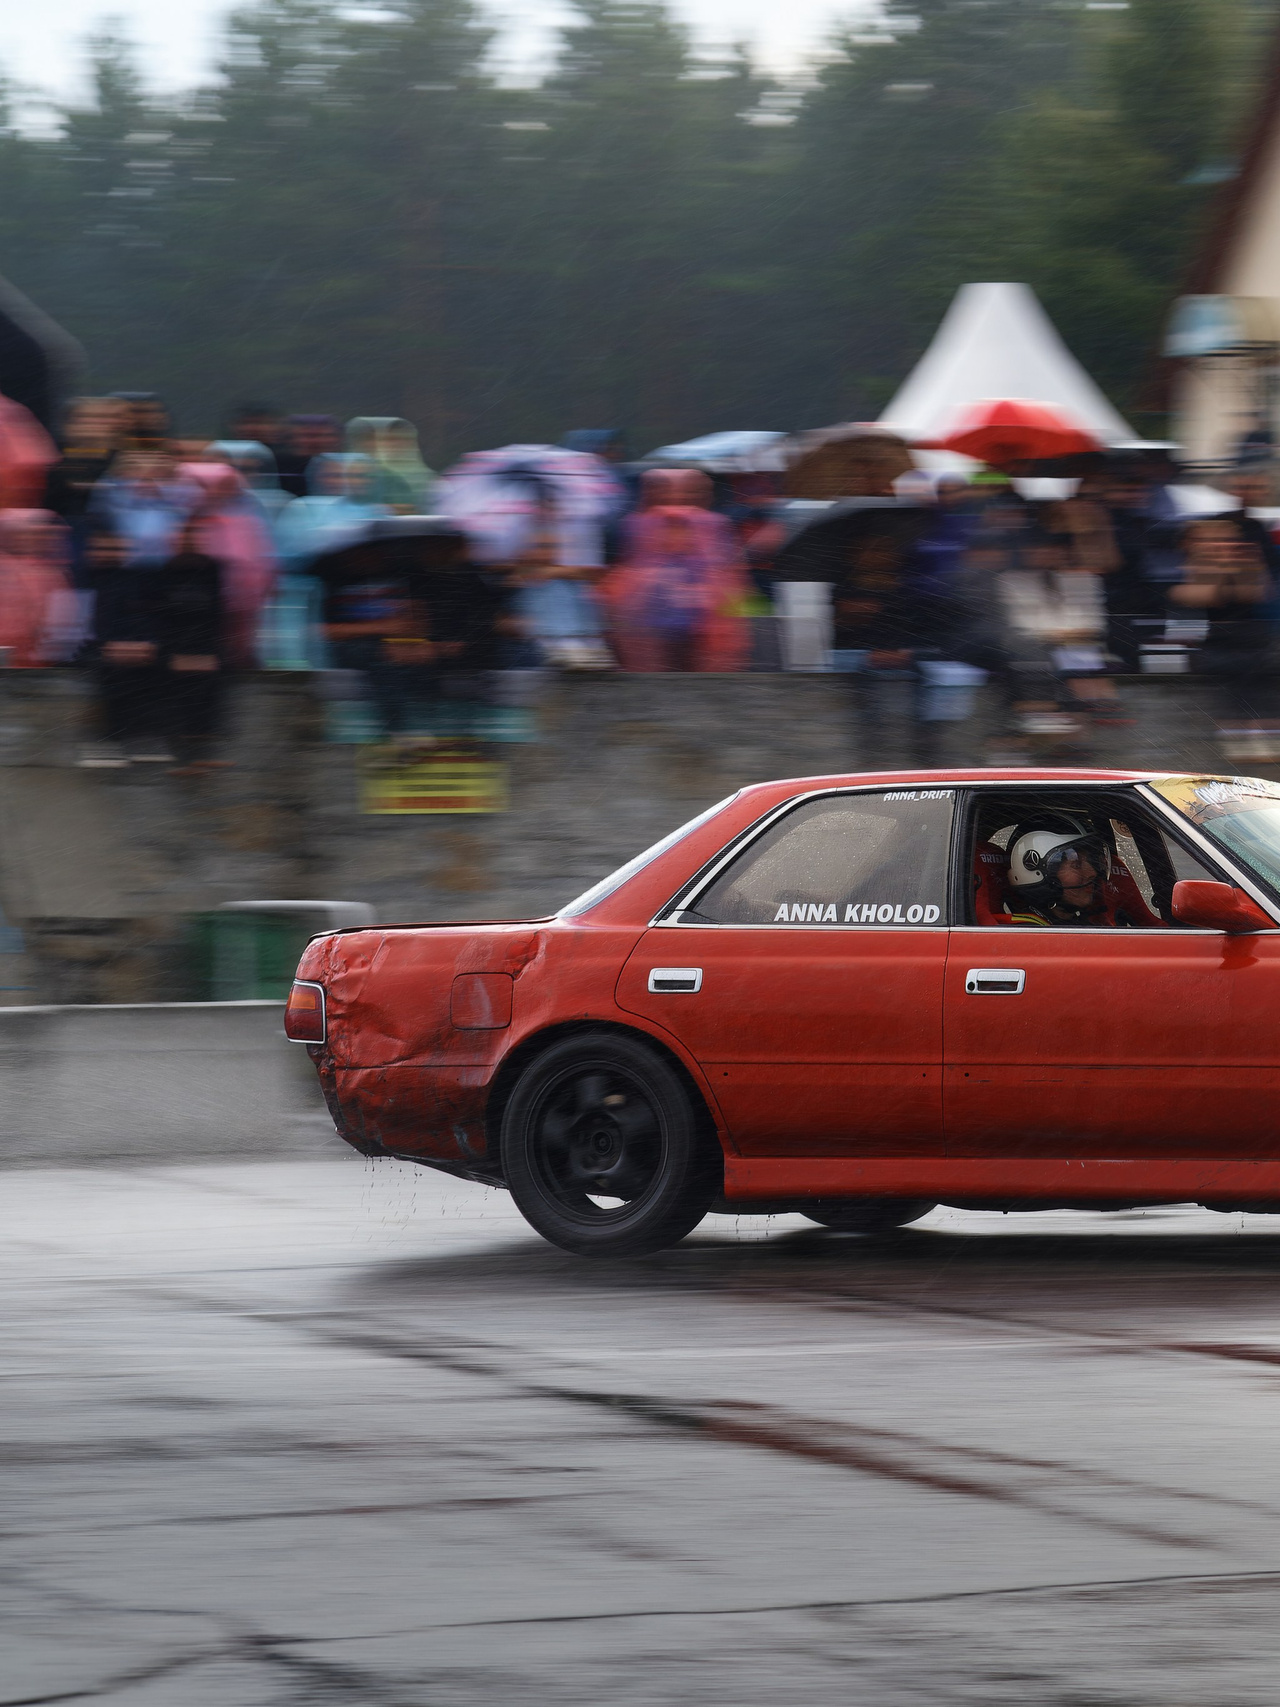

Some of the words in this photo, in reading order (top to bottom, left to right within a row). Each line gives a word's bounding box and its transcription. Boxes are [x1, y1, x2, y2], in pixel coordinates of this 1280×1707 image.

[883, 790, 953, 802] ANNA_DRIFT
[774, 903, 838, 922] ANNA
[844, 904, 940, 923] KHOLOD
